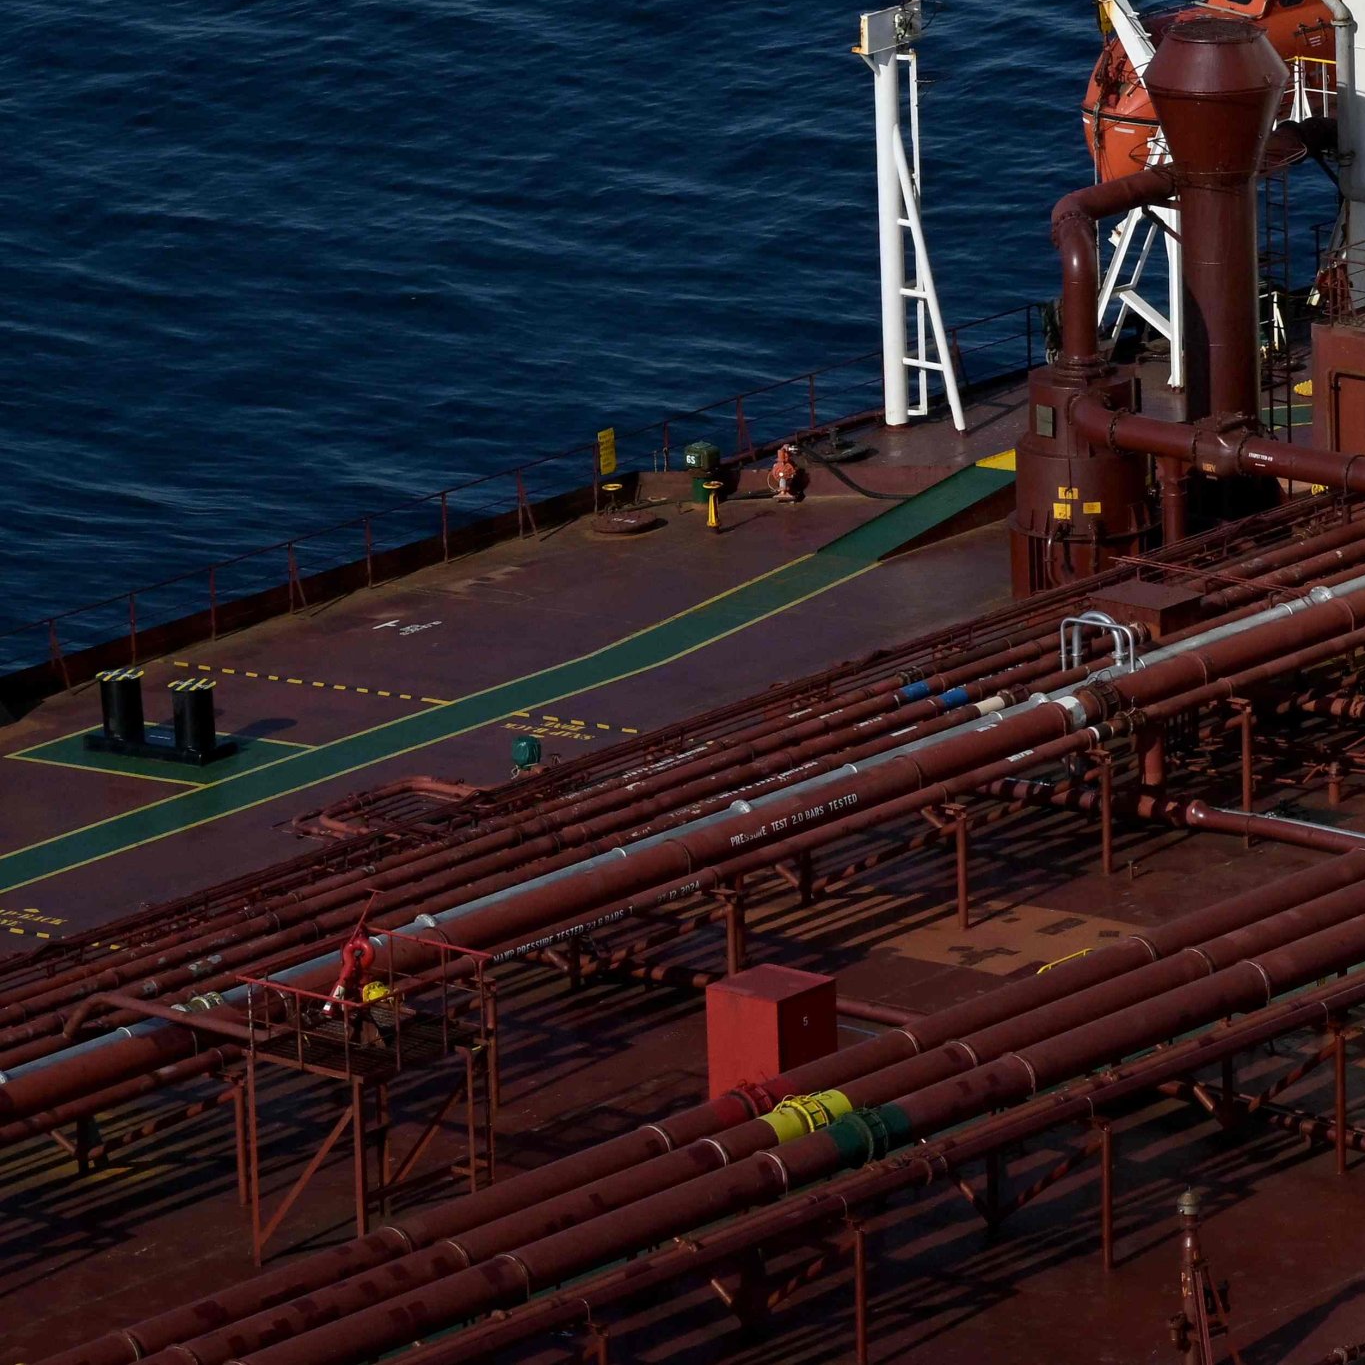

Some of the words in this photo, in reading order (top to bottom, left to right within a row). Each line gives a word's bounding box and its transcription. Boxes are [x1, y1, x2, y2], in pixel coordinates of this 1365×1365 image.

[770, 817, 788, 832] TEST
[805, 805, 825, 821] BARS
[828, 793, 859, 812] TESTED
